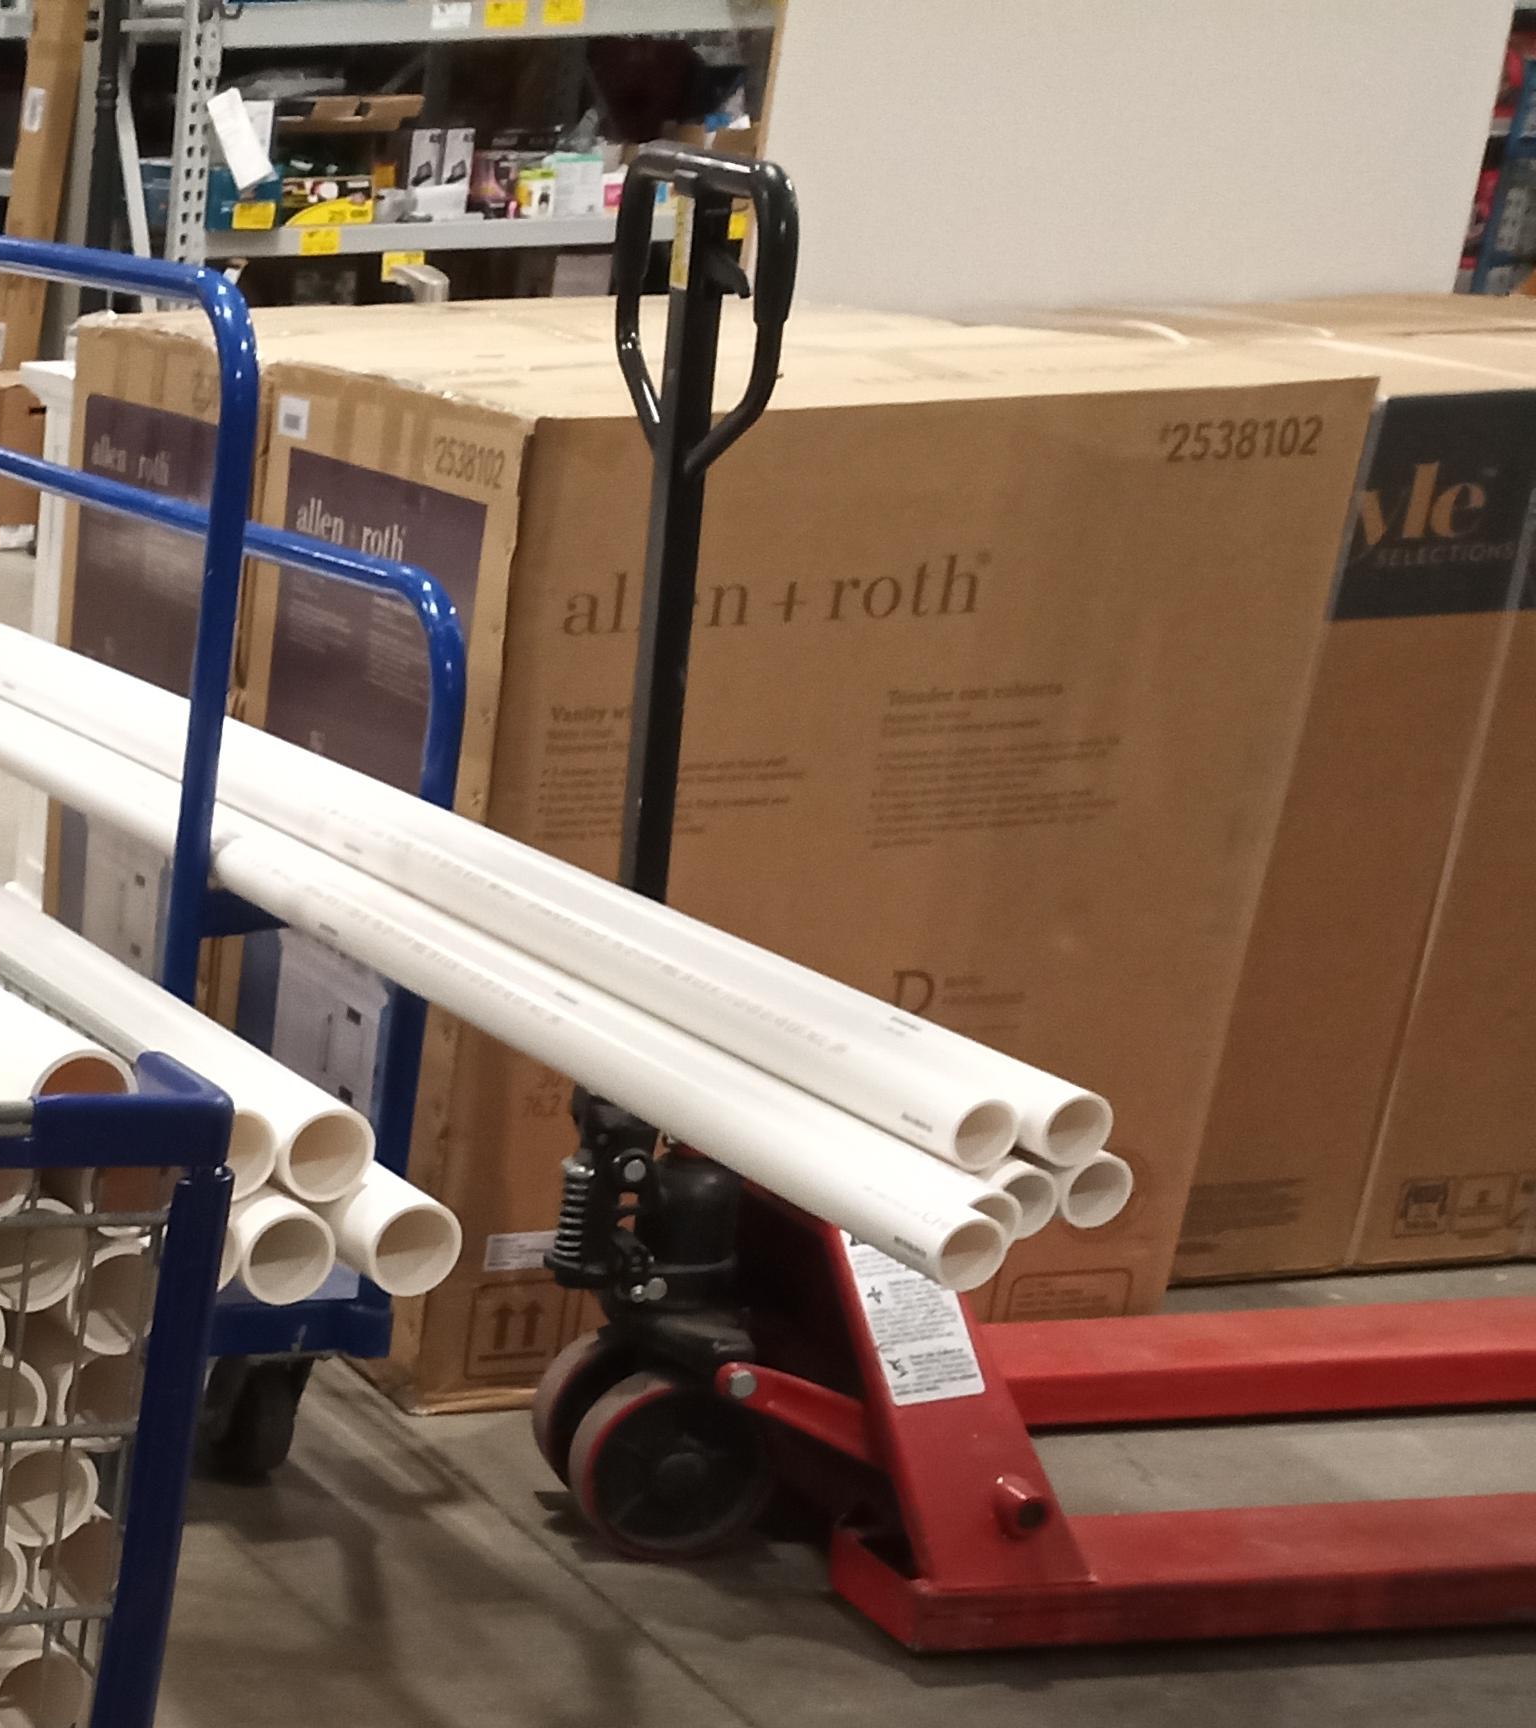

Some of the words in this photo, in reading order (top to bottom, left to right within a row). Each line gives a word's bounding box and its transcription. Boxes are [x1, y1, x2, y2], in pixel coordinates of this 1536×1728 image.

[295, 496, 345, 546] allen
[561, 570, 750, 637] aln
[828, 553, 981, 622] roth
